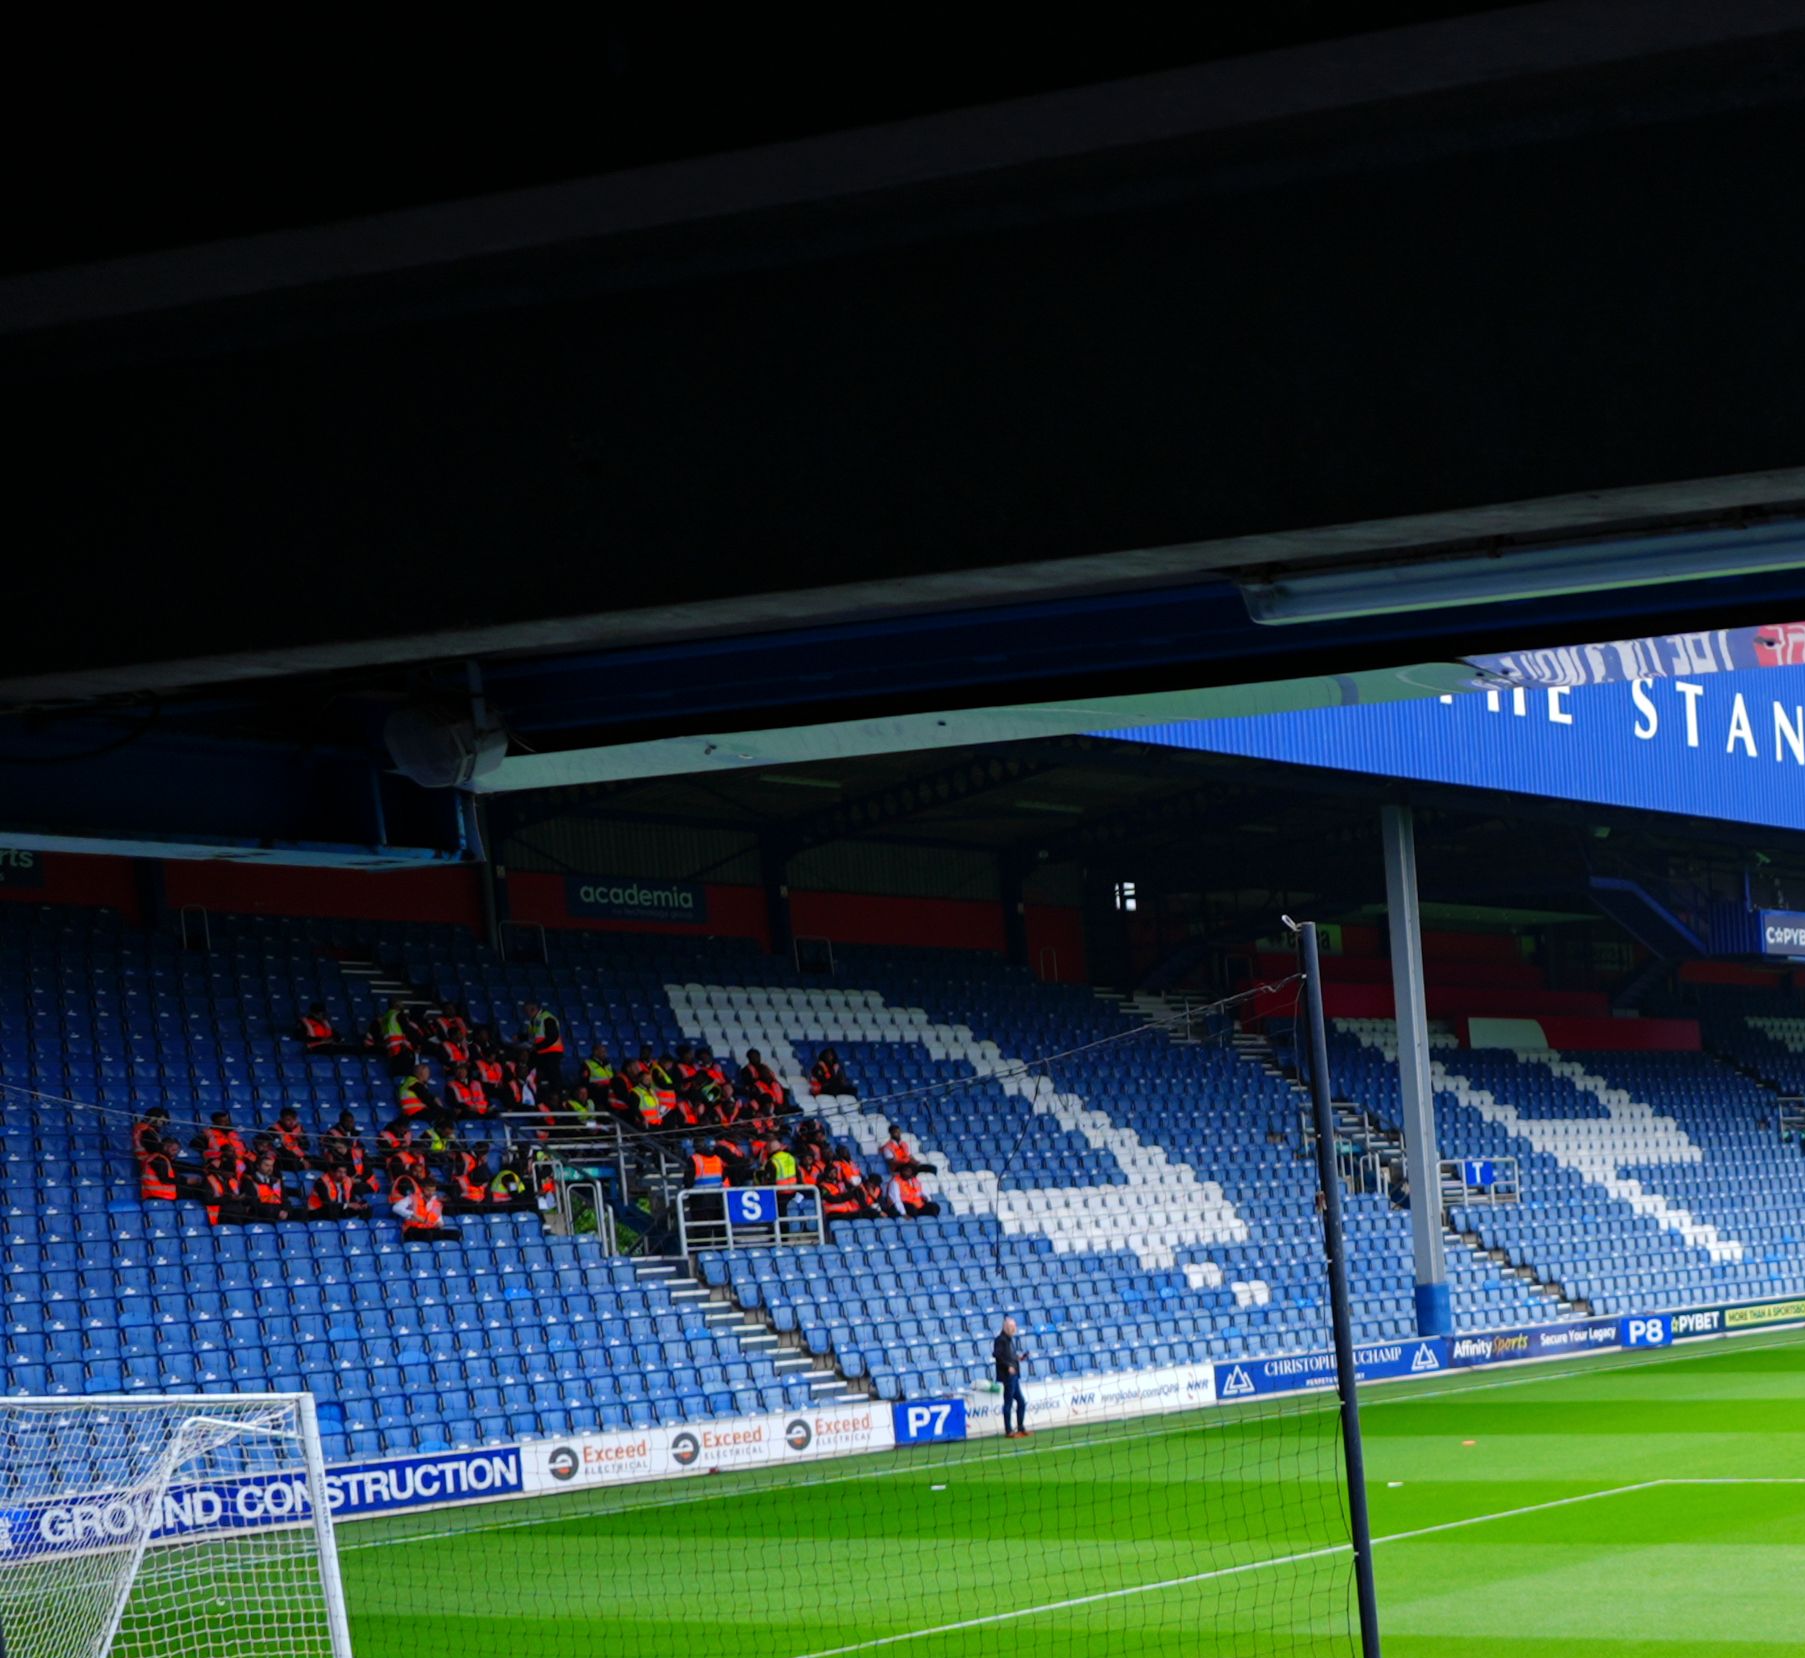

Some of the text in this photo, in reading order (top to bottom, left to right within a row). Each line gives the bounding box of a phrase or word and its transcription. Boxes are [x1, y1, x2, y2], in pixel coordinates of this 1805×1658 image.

[579, 883, 695, 910] academia
[1471, 1161, 1484, 1186] T
[741, 1190, 763, 1221] S
[1672, 1310, 1720, 1333] PYBET
[1727, 1310, 1748, 1323] MORE
[1749, 1307, 1766, 1321] THAN
[1540, 1325, 1617, 1347] Secure Your Legacy
[1628, 1318, 1665, 1345] P8
[1187, 1378, 1209, 1392] NNR
[1070, 1392, 1096, 1406] NNR
[815, 1414, 872, 1436] Exceed
[906, 1403, 953, 1438] P7
[702, 1426, 763, 1448] Exceed
[815, 1432, 872, 1447] ELECTRICAL
[582, 1440, 647, 1463] Exceed
[704, 1446, 765, 1462] ELECTRICAL
[585, 1461, 649, 1476] ELECTRICAL
[39, 1490, 223, 1543] GROUND
[236, 1454, 519, 1519] CONSTRUCTION
